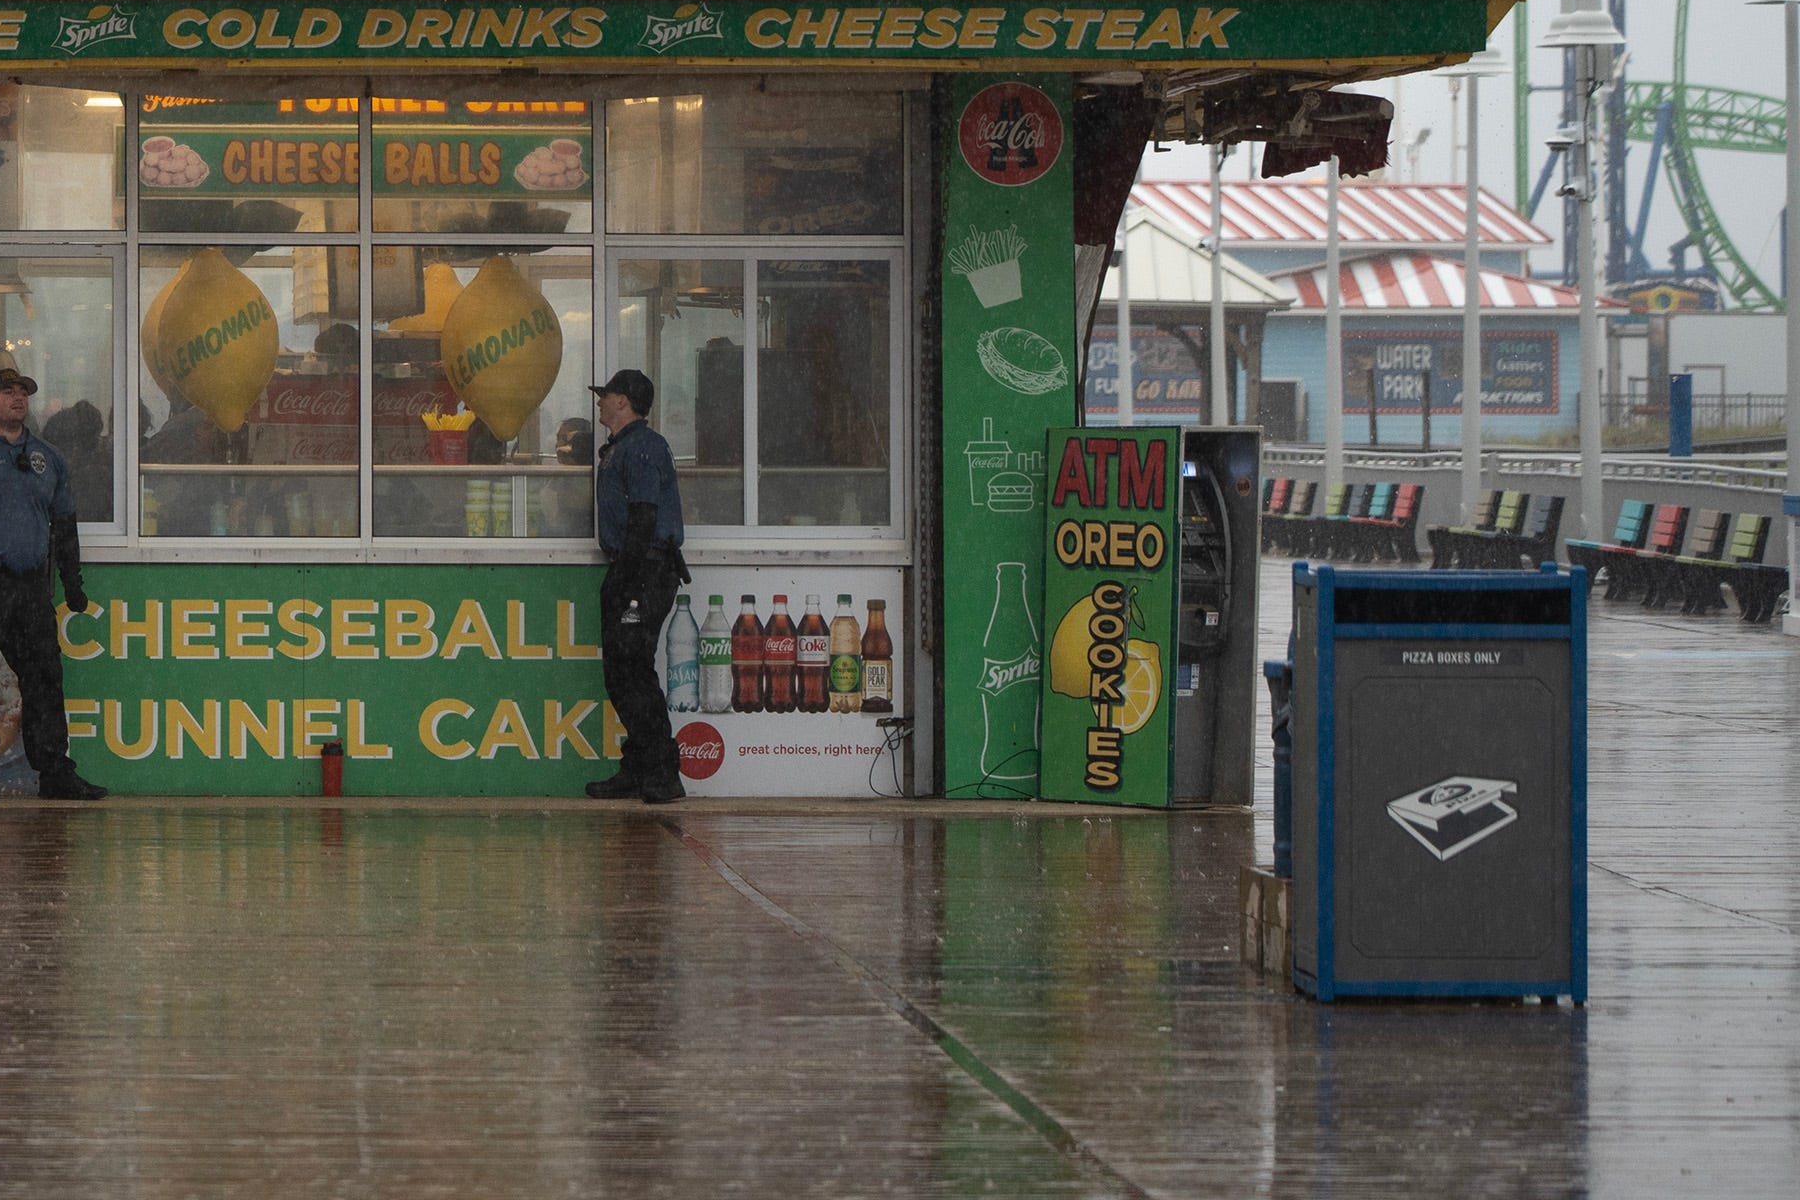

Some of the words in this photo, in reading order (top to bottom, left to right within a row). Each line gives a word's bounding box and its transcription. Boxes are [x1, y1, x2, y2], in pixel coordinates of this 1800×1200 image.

[60, 12, 130, 50] Sprite
[162, 7, 353, 50] COLD
[357, 7, 610, 50] DRINKS
[648, 10, 716, 47] Sprite
[744, 7, 1006, 50] CHEESE
[1015, 6, 1242, 50] STEAK
[976, 113, 1046, 150] Coca-Cola
[222, 139, 358, 185] CHEESE
[384, 141, 502, 186] BALLS
[1377, 345, 1432, 369] WATER
[1496, 359, 1543, 372] Games
[1095, 378, 1119, 394] FU
[1137, 380, 1161, 400] GO
[1166, 379, 1200, 400] KAR
[1453, 391, 1544, 404] ARACTIONS
[274, 389, 355, 415] Coca-Cola
[1051, 437, 1165, 510] ATM
[1054, 521, 1165, 570] OREO
[799, 638, 826, 651] Coke
[1402, 651, 1434, 664] PIZZA
[1438, 651, 1470, 664] BOXES
[1474, 651, 1501, 664] ONLY
[668, 666, 697, 685] DASAN
[868, 666, 886, 675] GOLD
[868, 676, 886, 686] PEAK
[984, 656, 1040, 688] Sprite
[1088, 581, 1127, 790] COOKIES
[62, 697, 393, 761] FUNNEL
[739, 745, 769, 757] great
[773, 743, 821, 756] choices,
[824, 743, 853, 757] right
[856, 744, 885, 756] here.
